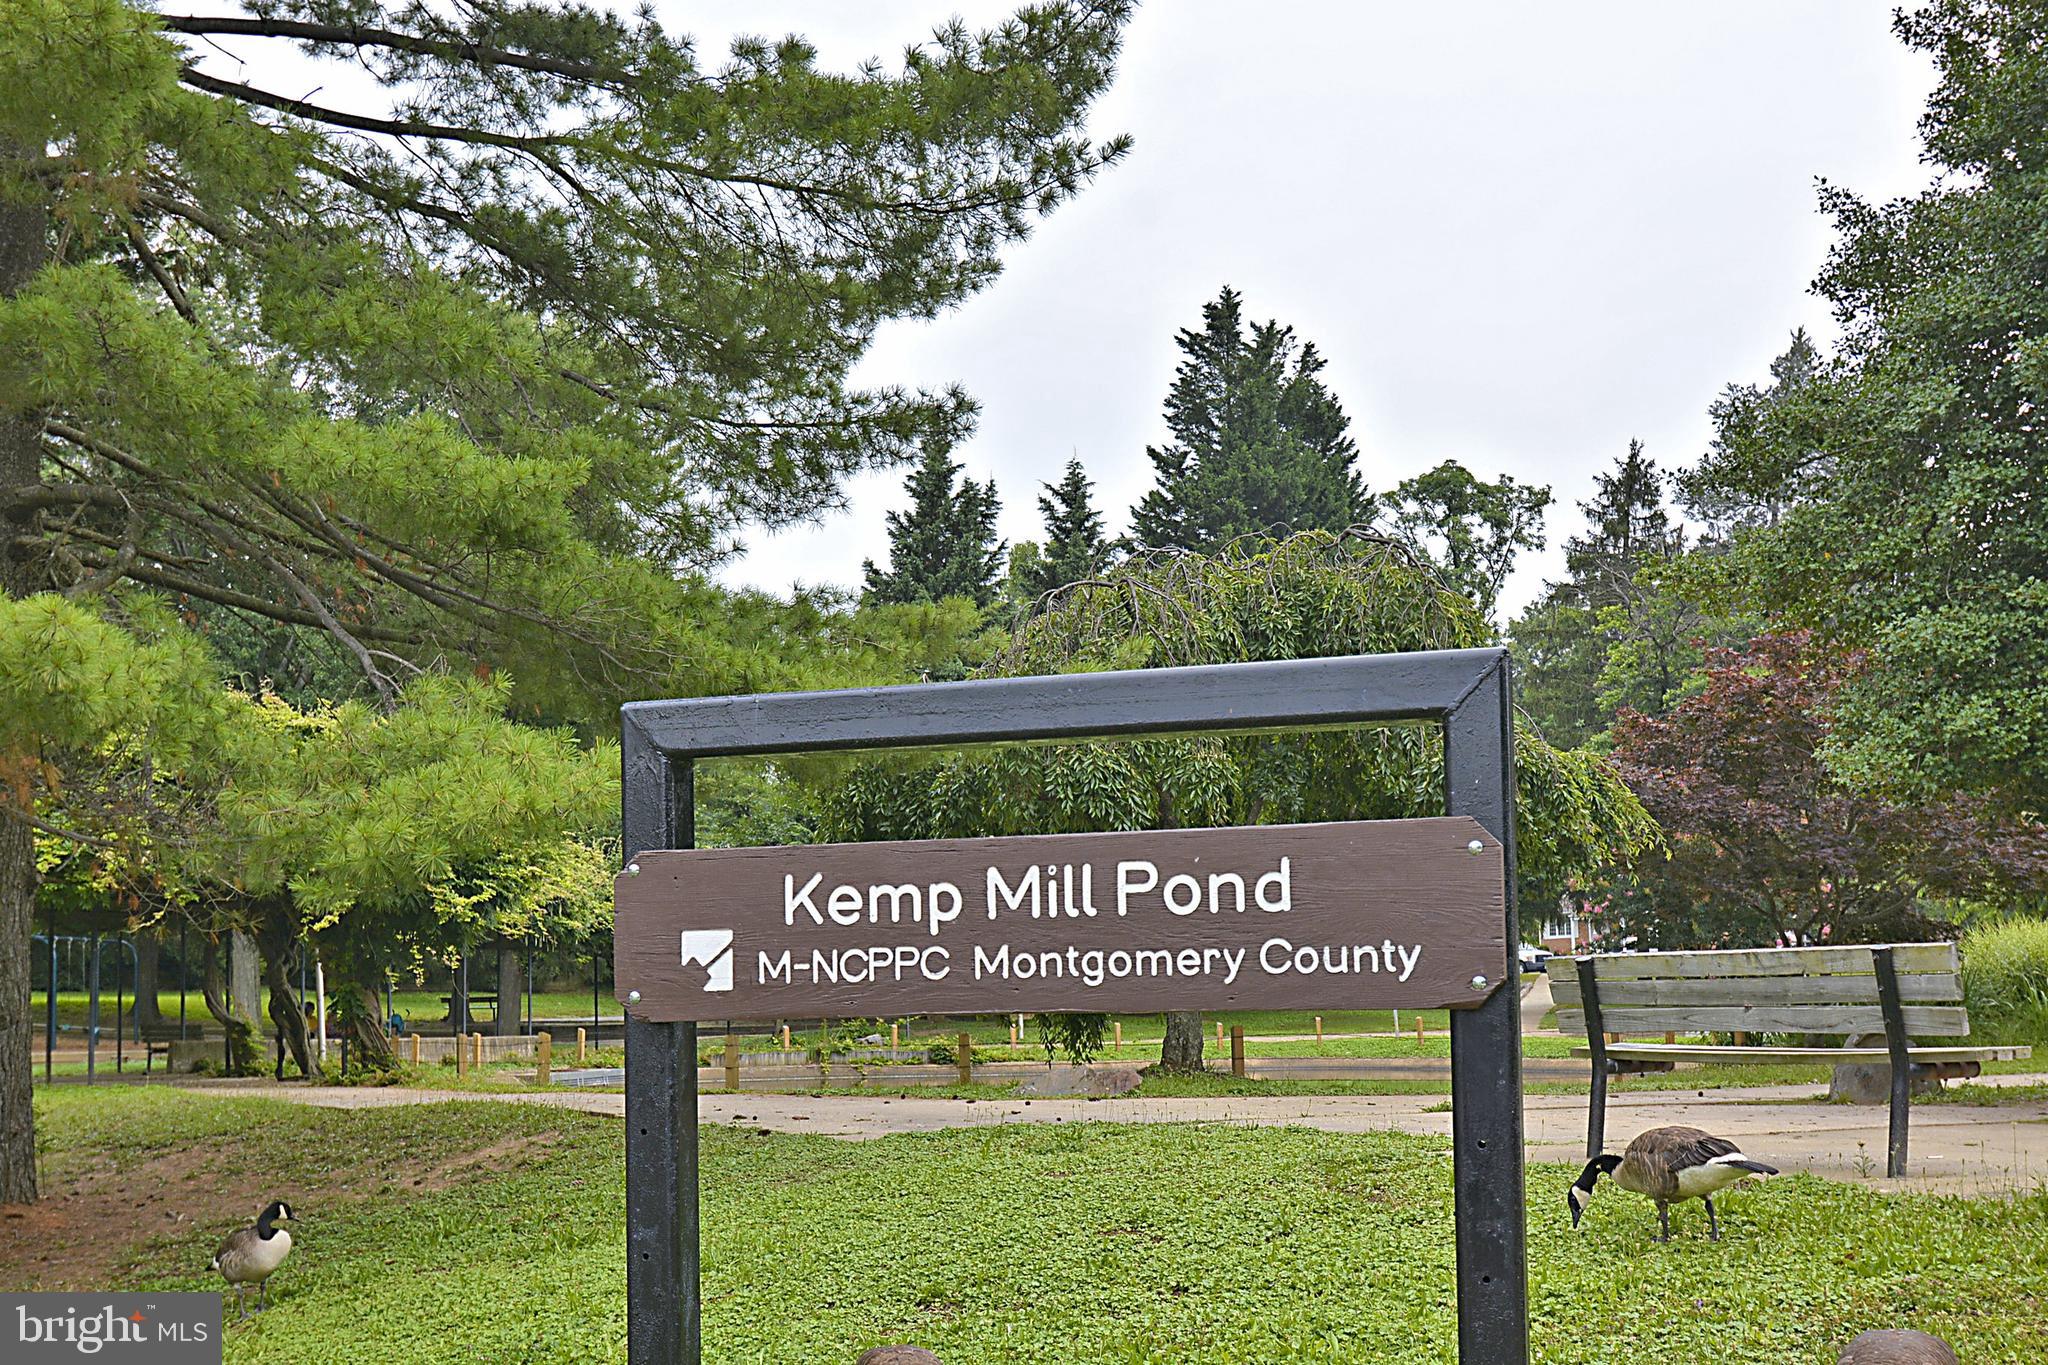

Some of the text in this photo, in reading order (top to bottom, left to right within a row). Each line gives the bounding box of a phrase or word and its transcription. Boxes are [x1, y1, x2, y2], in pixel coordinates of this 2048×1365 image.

[784, 857, 1292, 936] Kemp Mill Pond
[758, 937, 1422, 987] M-NCPPC Montgomery County
